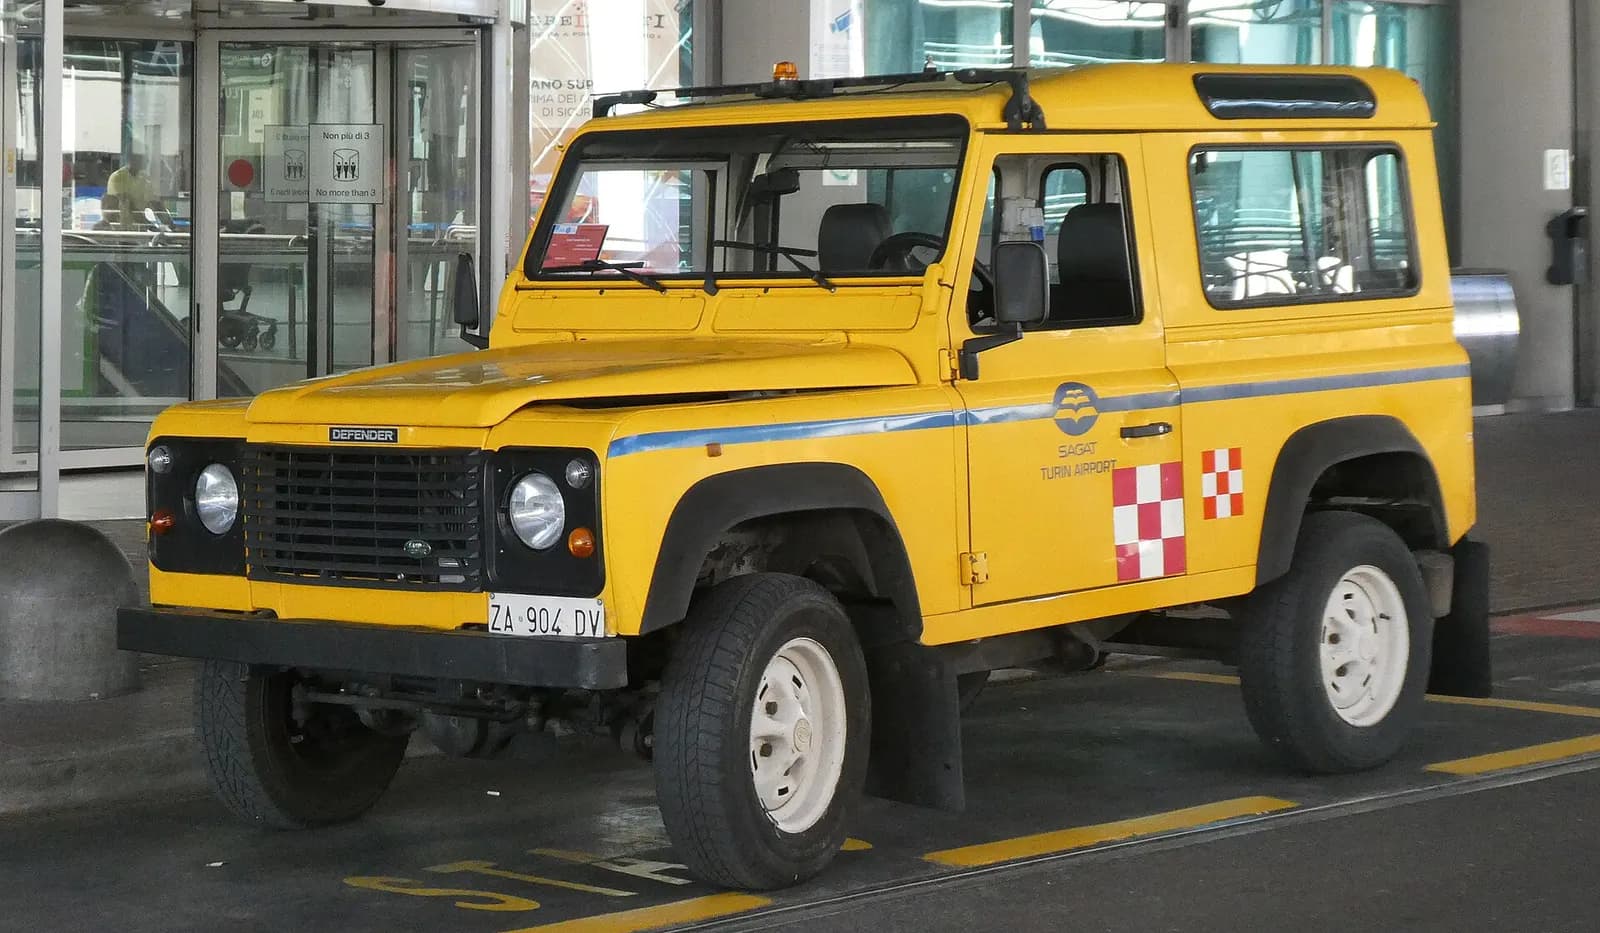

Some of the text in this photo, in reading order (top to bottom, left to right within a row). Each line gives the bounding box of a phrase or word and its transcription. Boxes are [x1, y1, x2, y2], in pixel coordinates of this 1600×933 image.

[531, 94, 554, 104] IMA
[542, 107, 554, 117] DI
[322, 132, 340, 140] Non
[355, 132, 363, 140] di
[364, 132, 370, 140] 3
[315, 189, 328, 197] No
[351, 188, 369, 197] than
[370, 189, 376, 197] 3
[332, 429, 394, 441] DEFENDER
[1058, 441, 1098, 458] SAGAT
[1040, 459, 1117, 481] TURIN AIRPORT
[490, 604, 600, 636] ZA 904 DV
